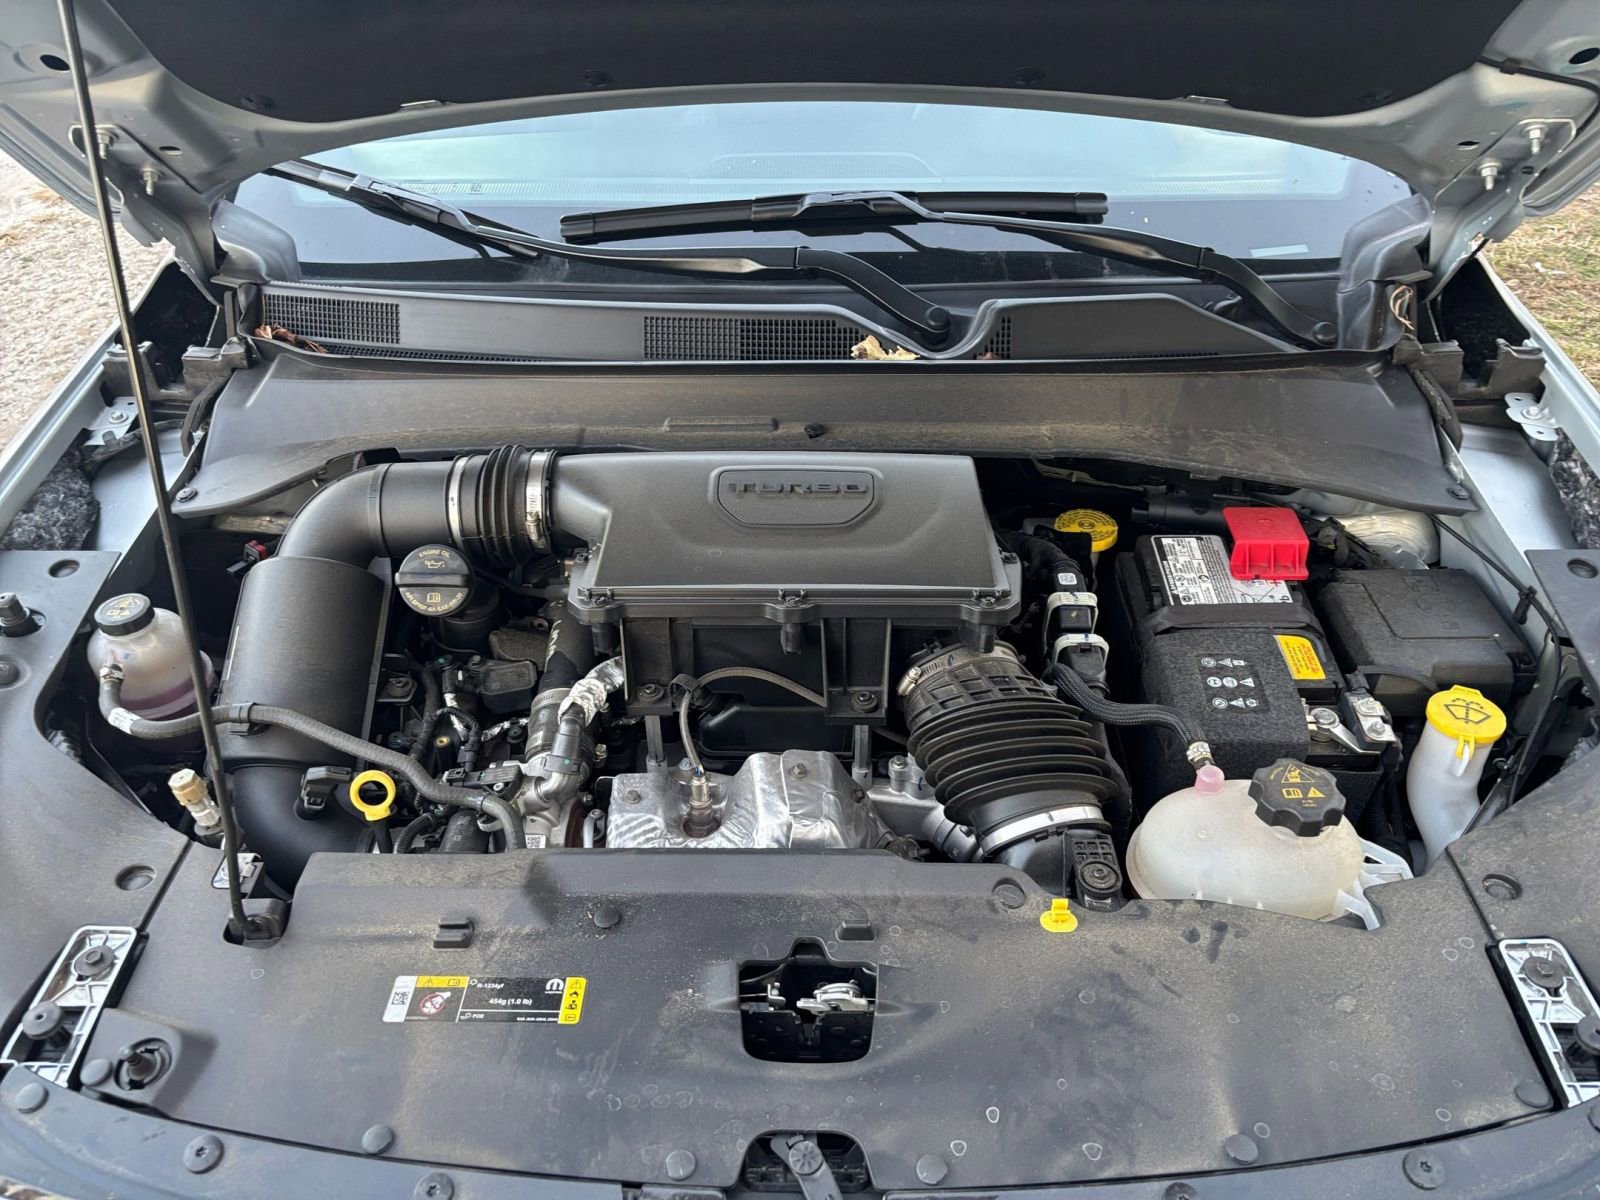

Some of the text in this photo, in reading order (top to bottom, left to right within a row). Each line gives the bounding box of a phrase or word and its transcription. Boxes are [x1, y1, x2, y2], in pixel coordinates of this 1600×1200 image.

[729, 481, 869, 495] TURBO
[419, 549, 451, 558] ENGINE OIL
[522, 998, 533, 1006] lb)
